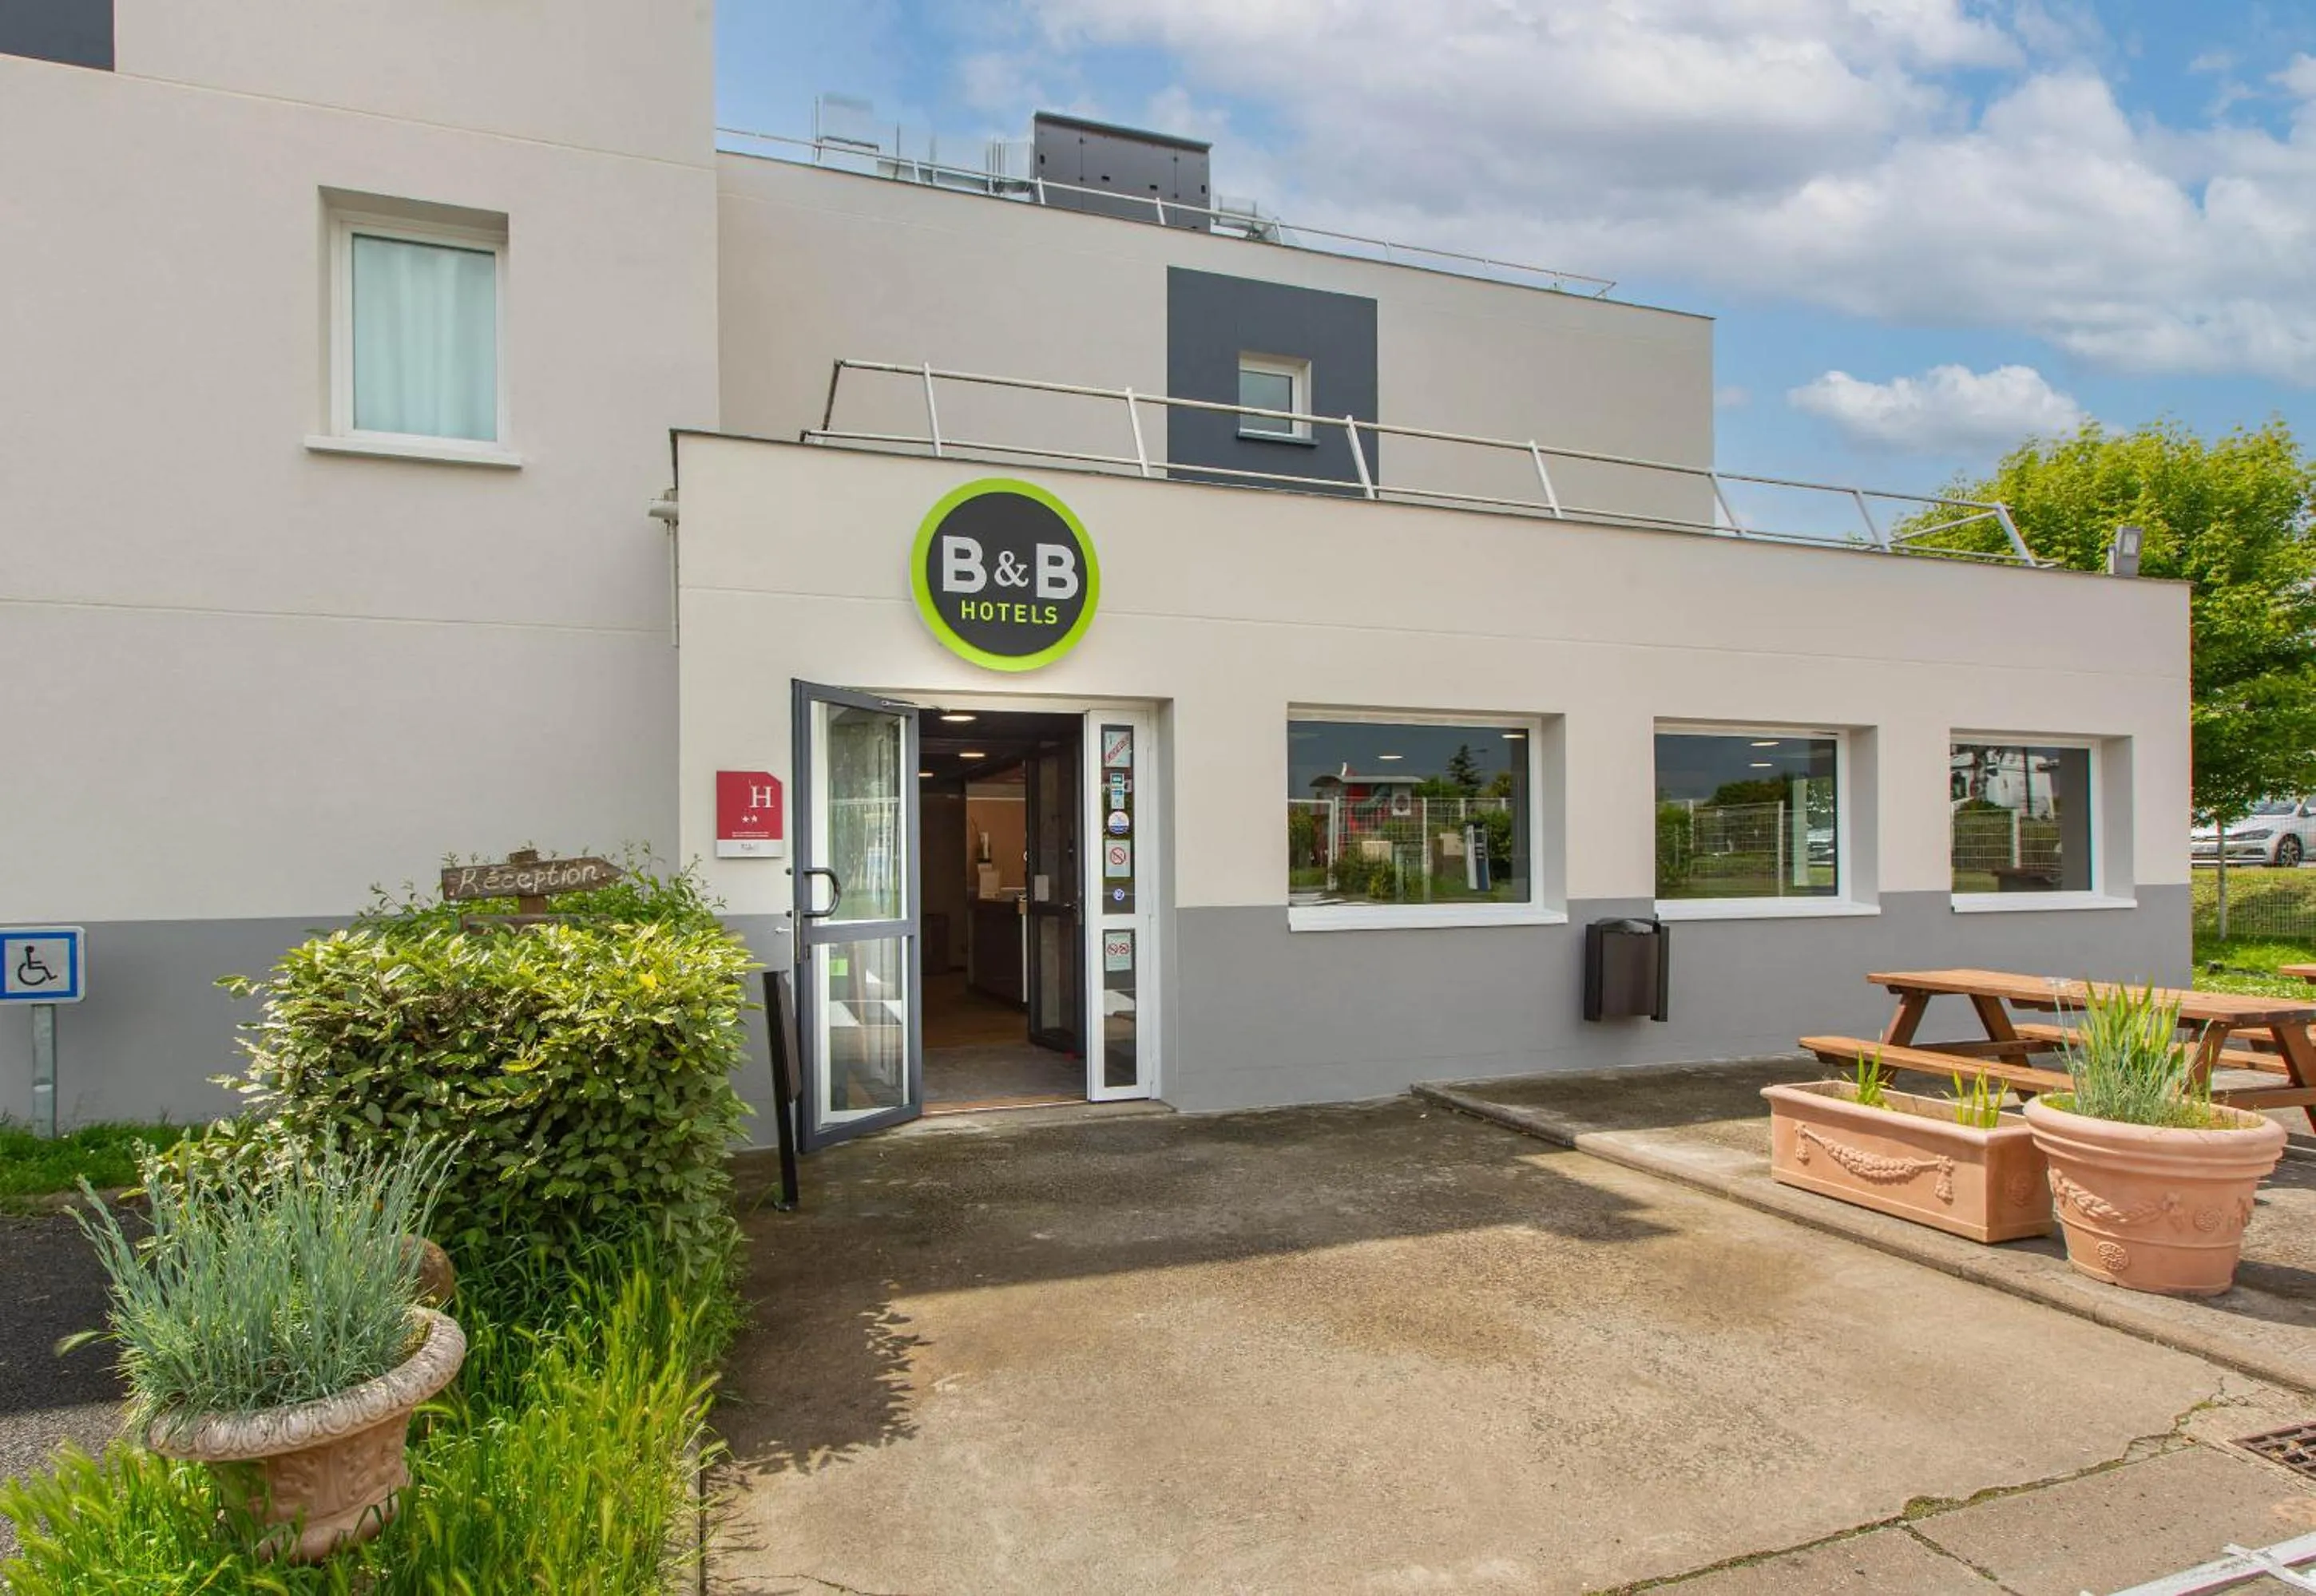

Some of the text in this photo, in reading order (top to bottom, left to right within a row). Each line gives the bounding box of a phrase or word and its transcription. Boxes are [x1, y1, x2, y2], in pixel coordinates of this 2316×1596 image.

[942, 535, 1079, 600] B&B
[961, 600, 1058, 625] HOTELS
[748, 785, 775, 808] H
[458, 863, 600, 894] Réception
